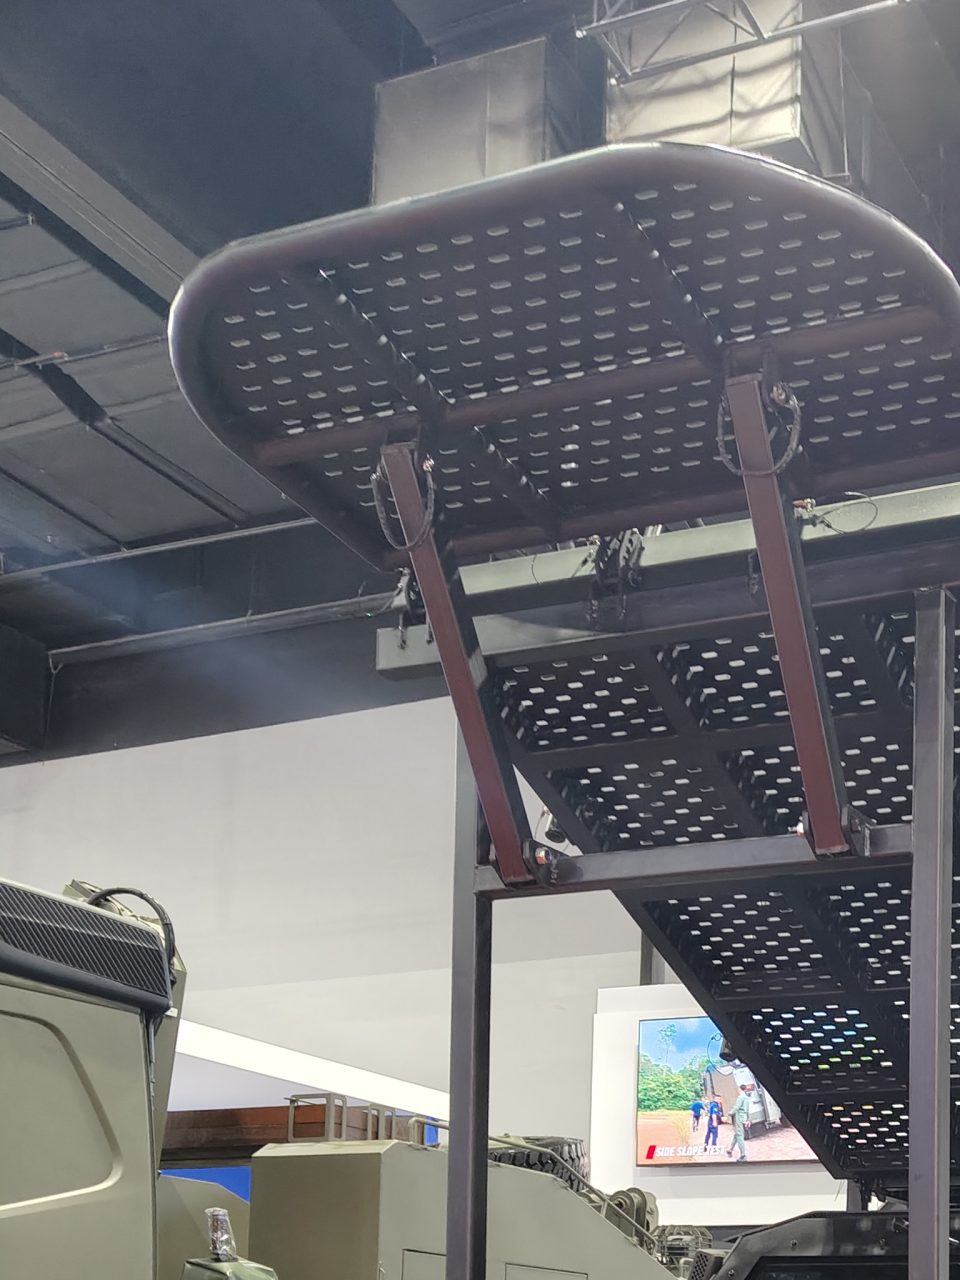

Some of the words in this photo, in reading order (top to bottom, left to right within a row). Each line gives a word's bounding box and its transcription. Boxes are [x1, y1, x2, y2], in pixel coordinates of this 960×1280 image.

[656, 1146, 675, 1157] SIDE
[677, 1146, 703, 1157] SLOPE
[705, 1145, 725, 1156] TEST
